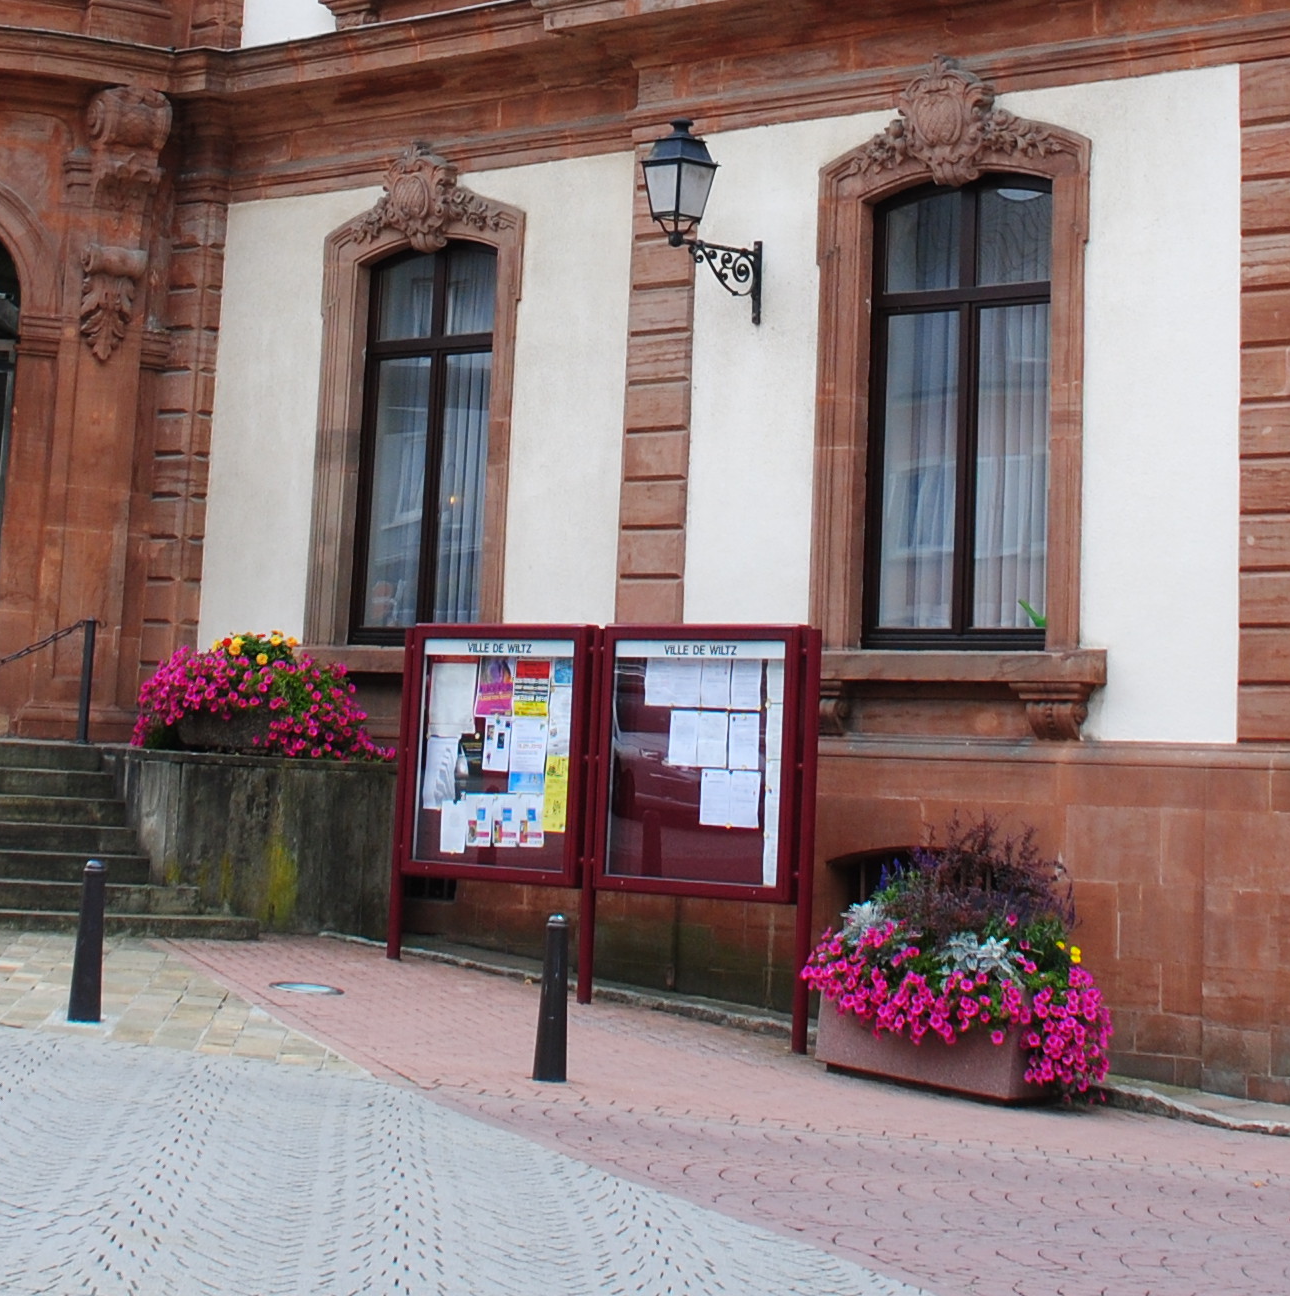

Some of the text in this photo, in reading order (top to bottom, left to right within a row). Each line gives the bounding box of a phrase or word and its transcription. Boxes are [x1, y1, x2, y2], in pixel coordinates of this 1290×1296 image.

[467, 642, 532, 654] VILLE DE WILTZ
[664, 645, 737, 655] VILLE DE WILTZ
